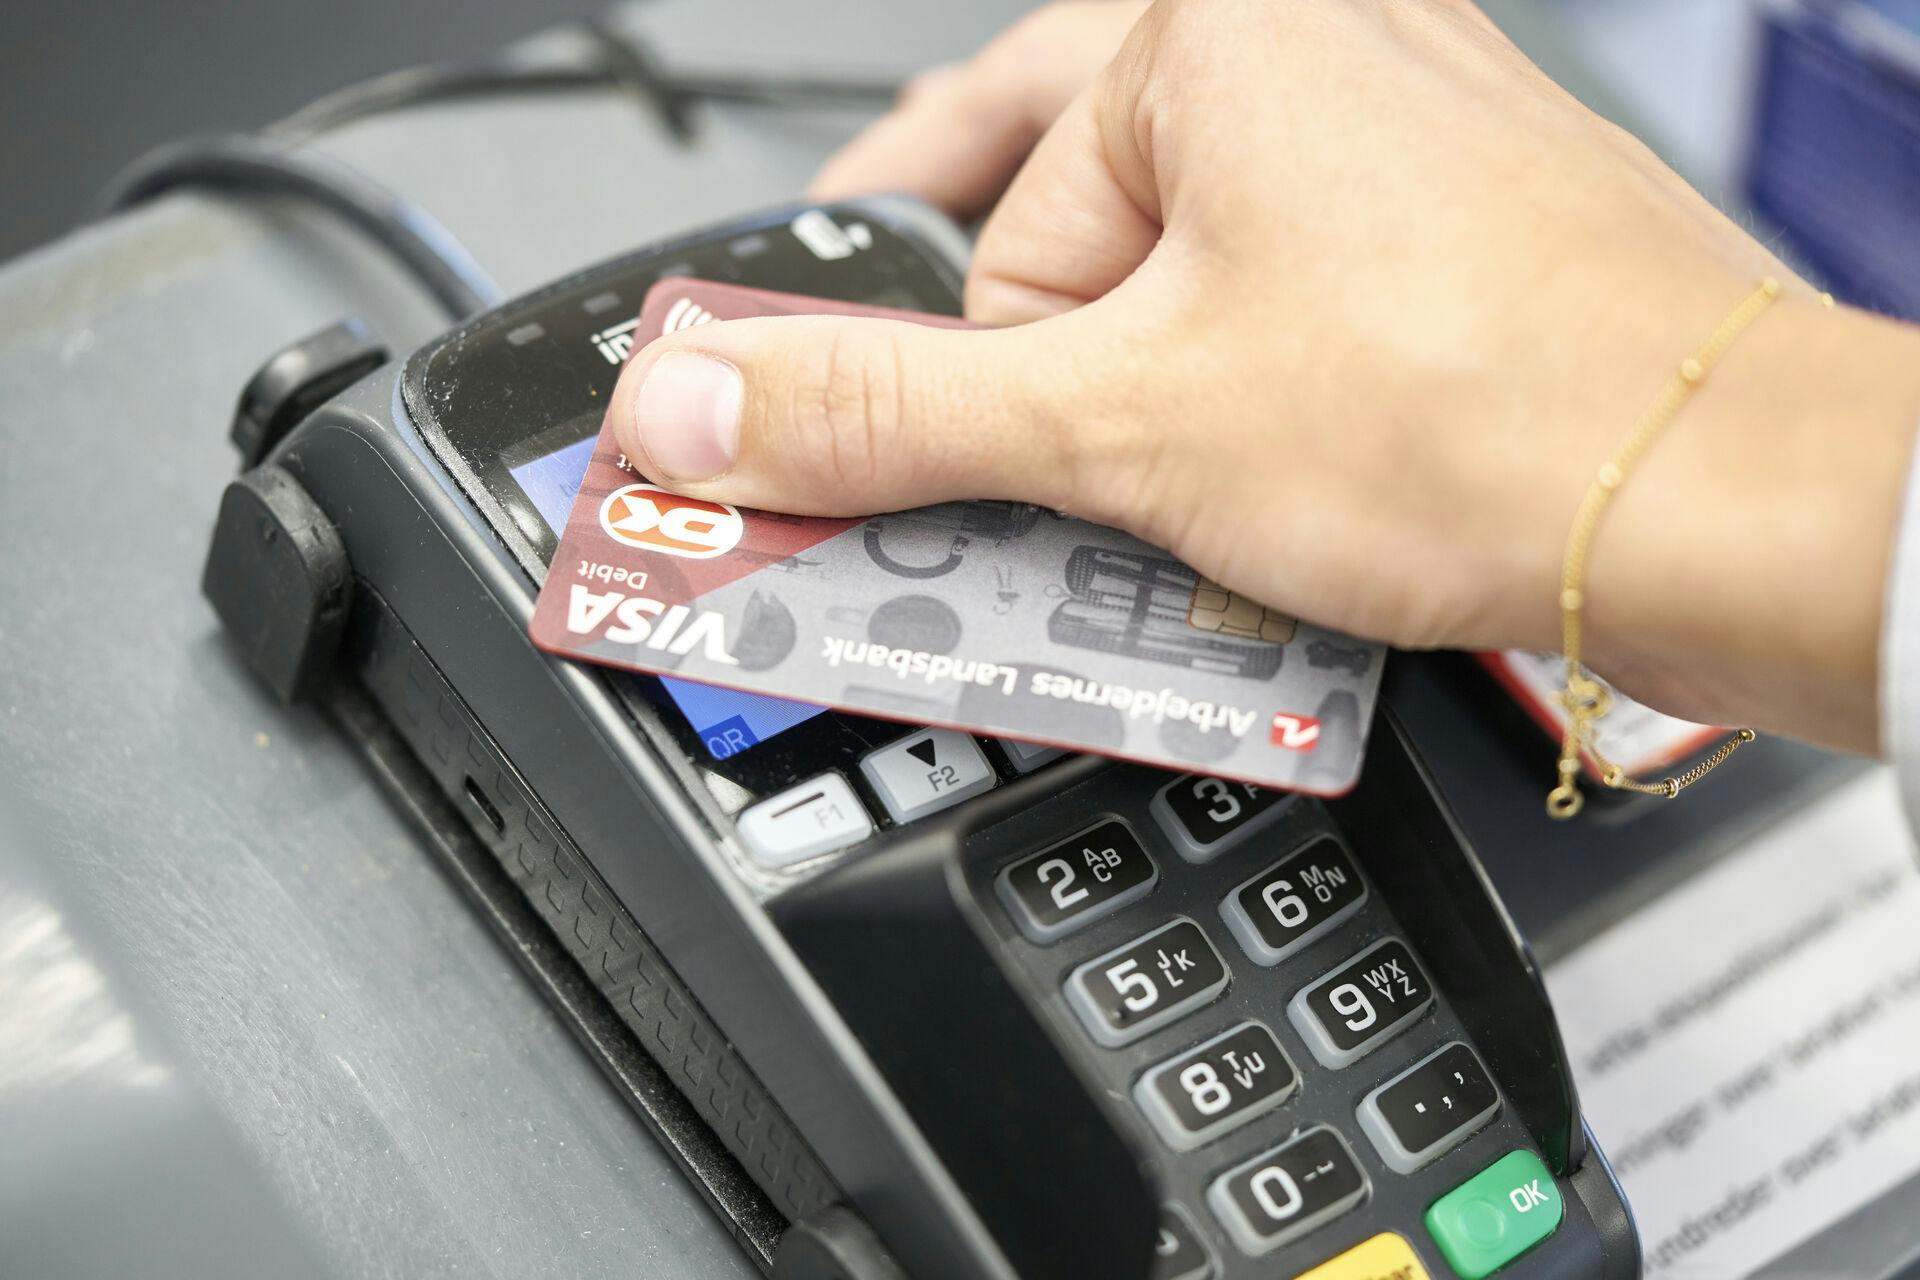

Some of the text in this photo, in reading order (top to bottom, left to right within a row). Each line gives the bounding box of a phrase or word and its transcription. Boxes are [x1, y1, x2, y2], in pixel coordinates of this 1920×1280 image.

[577, 560, 649, 590] Debit
[565, 584, 740, 666] VISA
[822, 636, 1019, 696] Landsbank
[1030, 672, 1257, 736] Arbejdernes
[928, 765, 961, 792] F2
[1193, 778, 1241, 822] 3
[814, 803, 846, 830] F1
[1036, 858, 1089, 910] 2
[1261, 879, 1309, 928] 6
[1106, 959, 1159, 1012] 5
[1328, 983, 1378, 1032] 9
[1179, 1062, 1232, 1116] 8
[1249, 1165, 1304, 1220] 0
[1509, 1179, 1549, 1213] OK
